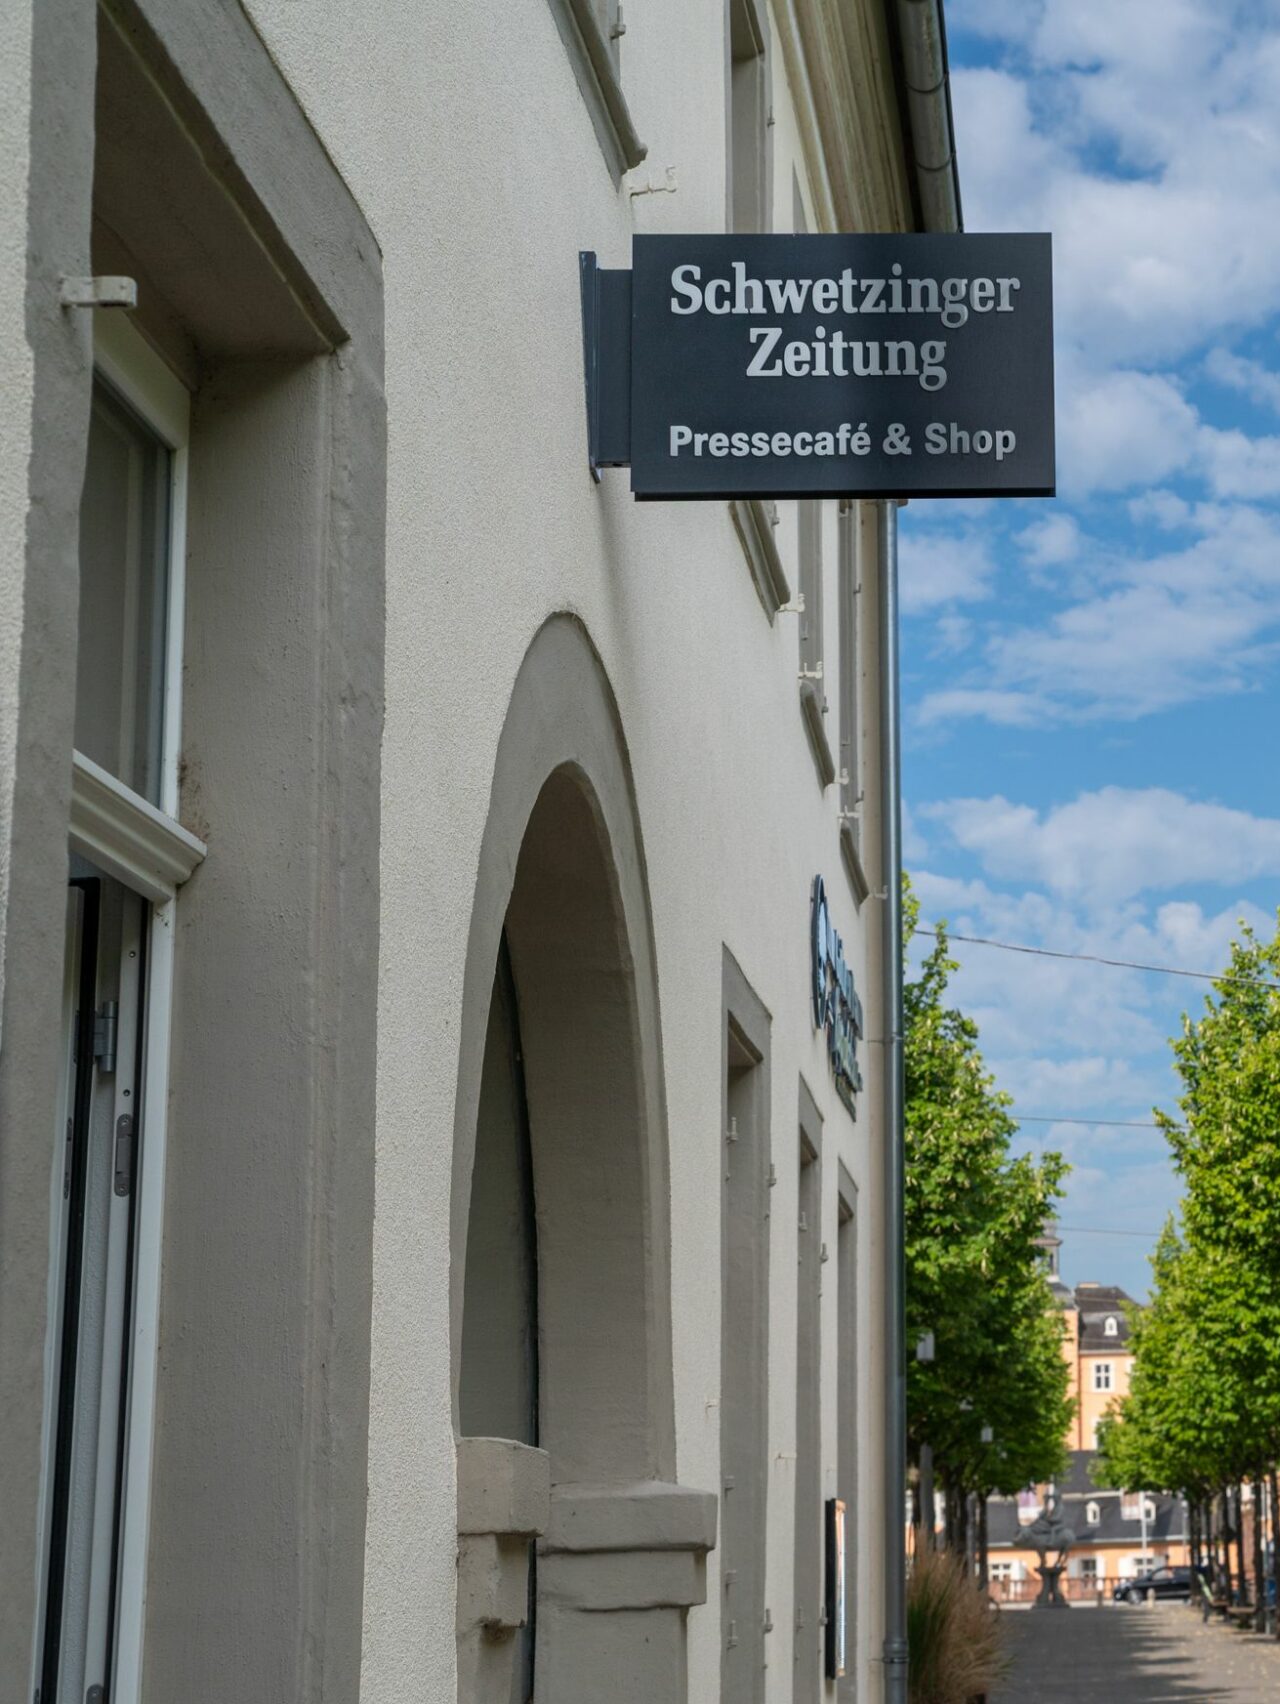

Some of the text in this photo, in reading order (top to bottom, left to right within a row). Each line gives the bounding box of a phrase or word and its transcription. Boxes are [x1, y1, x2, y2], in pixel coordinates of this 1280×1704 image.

[670, 261, 1021, 329] Schwetzinger
[746, 325, 947, 391] Zeitung
[669, 422, 1016, 461] Pressecafé & Shop
